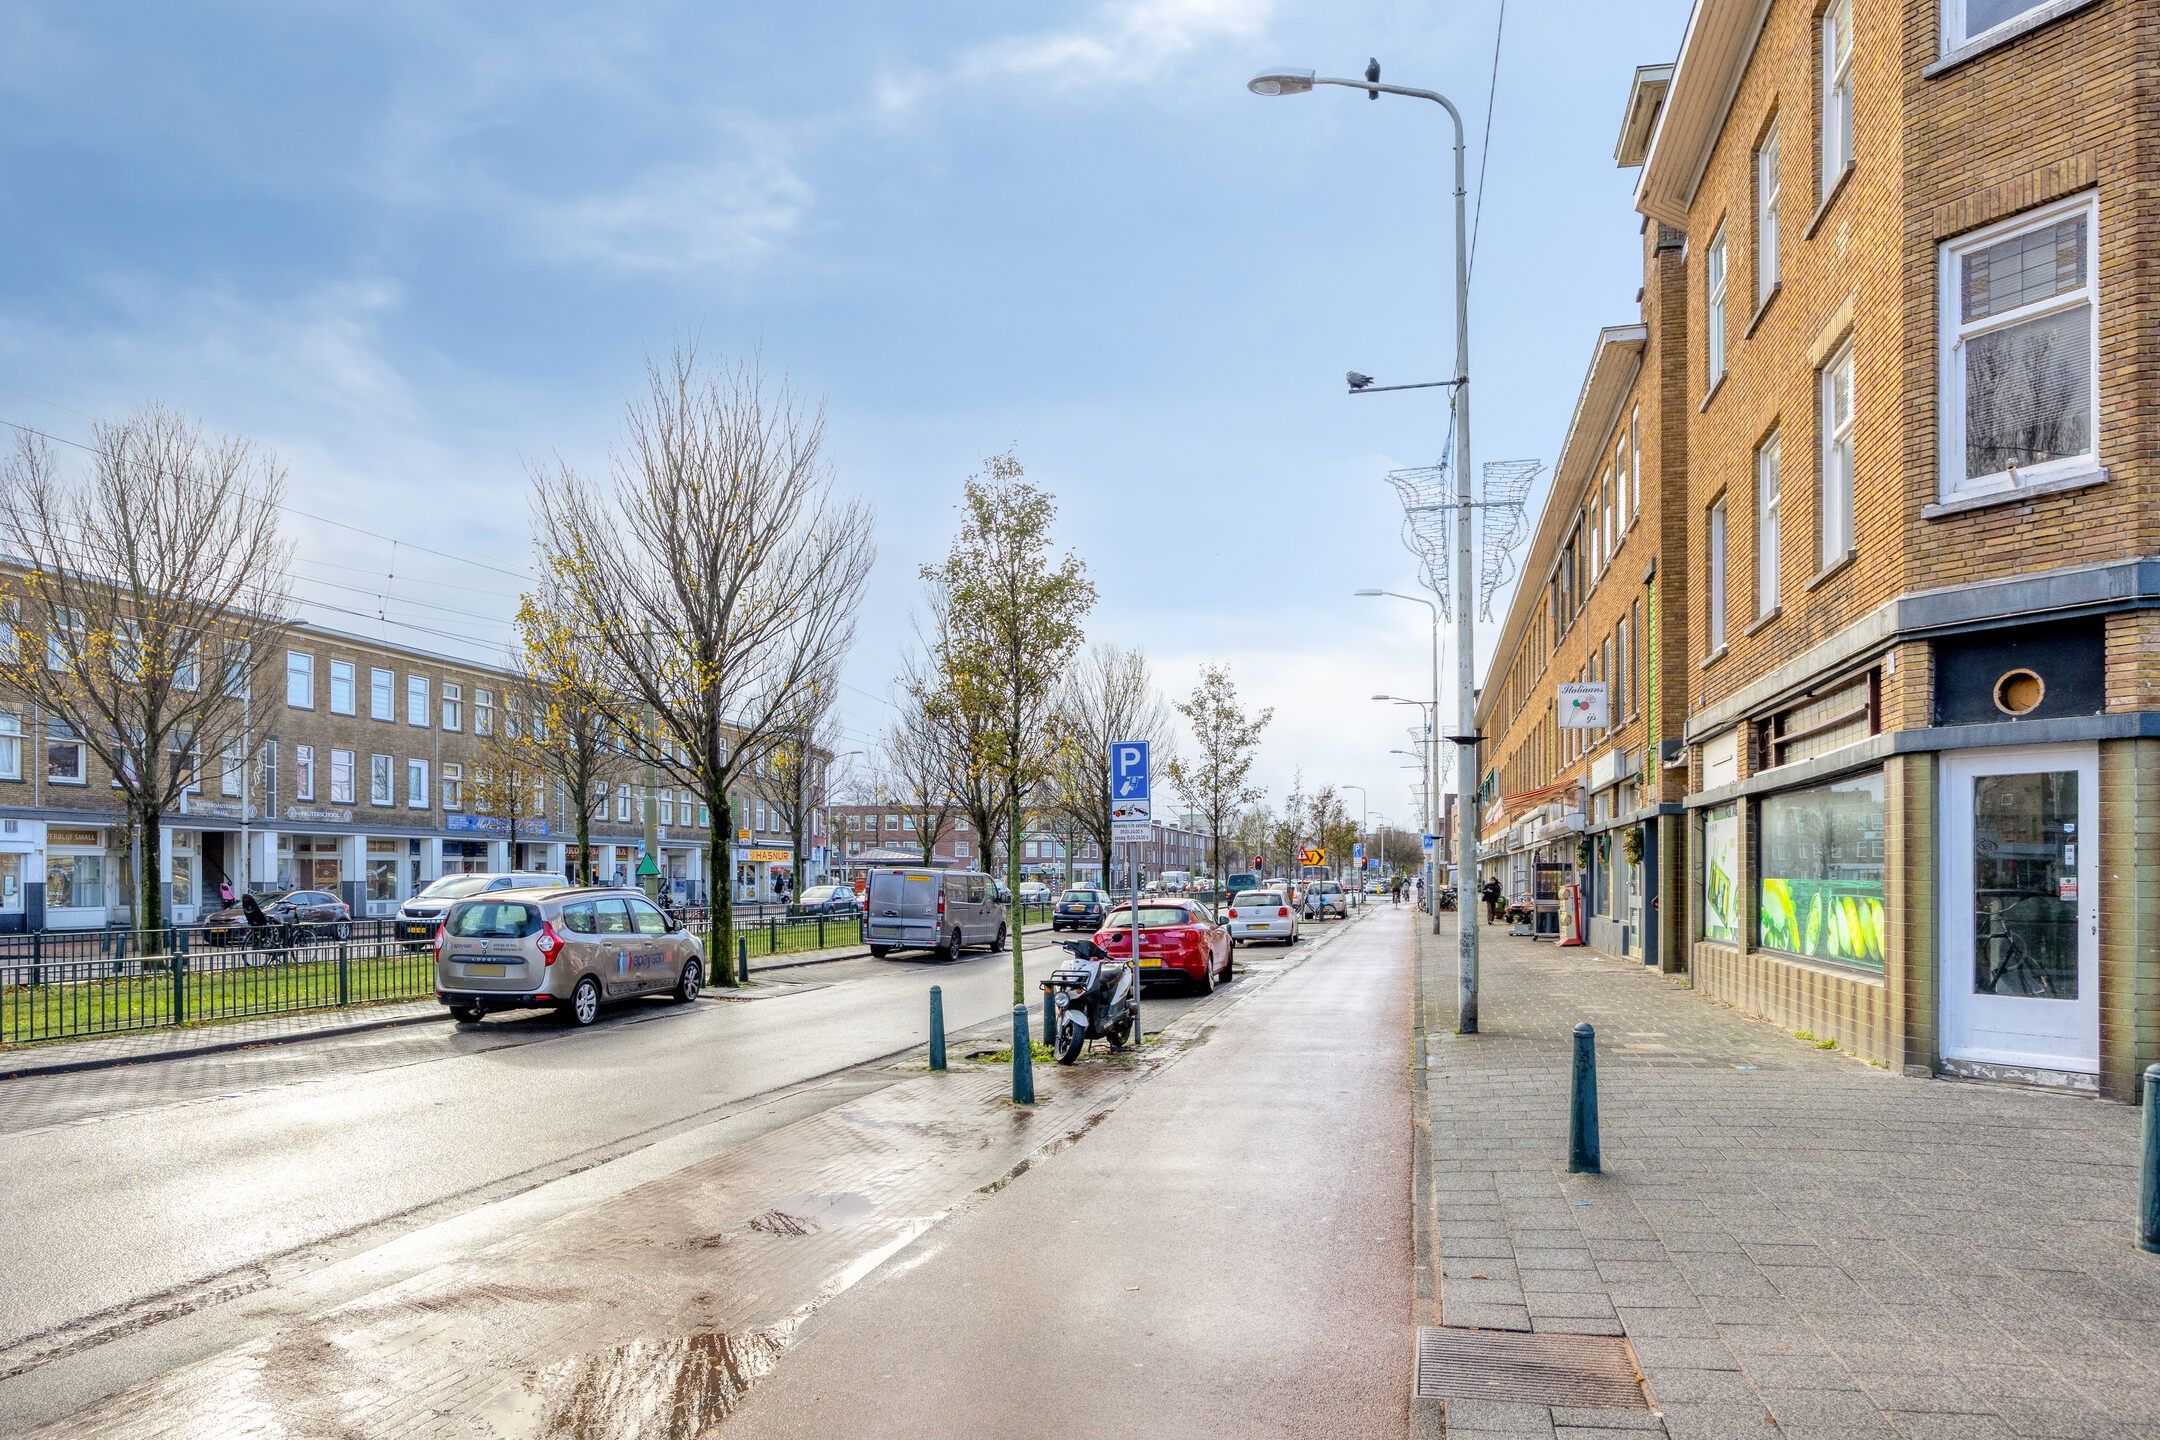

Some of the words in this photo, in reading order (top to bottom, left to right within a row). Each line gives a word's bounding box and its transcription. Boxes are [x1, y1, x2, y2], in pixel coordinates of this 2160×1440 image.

[1561, 684, 1604, 694] Italiaans
[1586, 712, 1597, 724] ijs
[1120, 747, 1141, 777] P
[74, 833, 96, 841] SMALL
[756, 851, 788, 860] HASNUR
